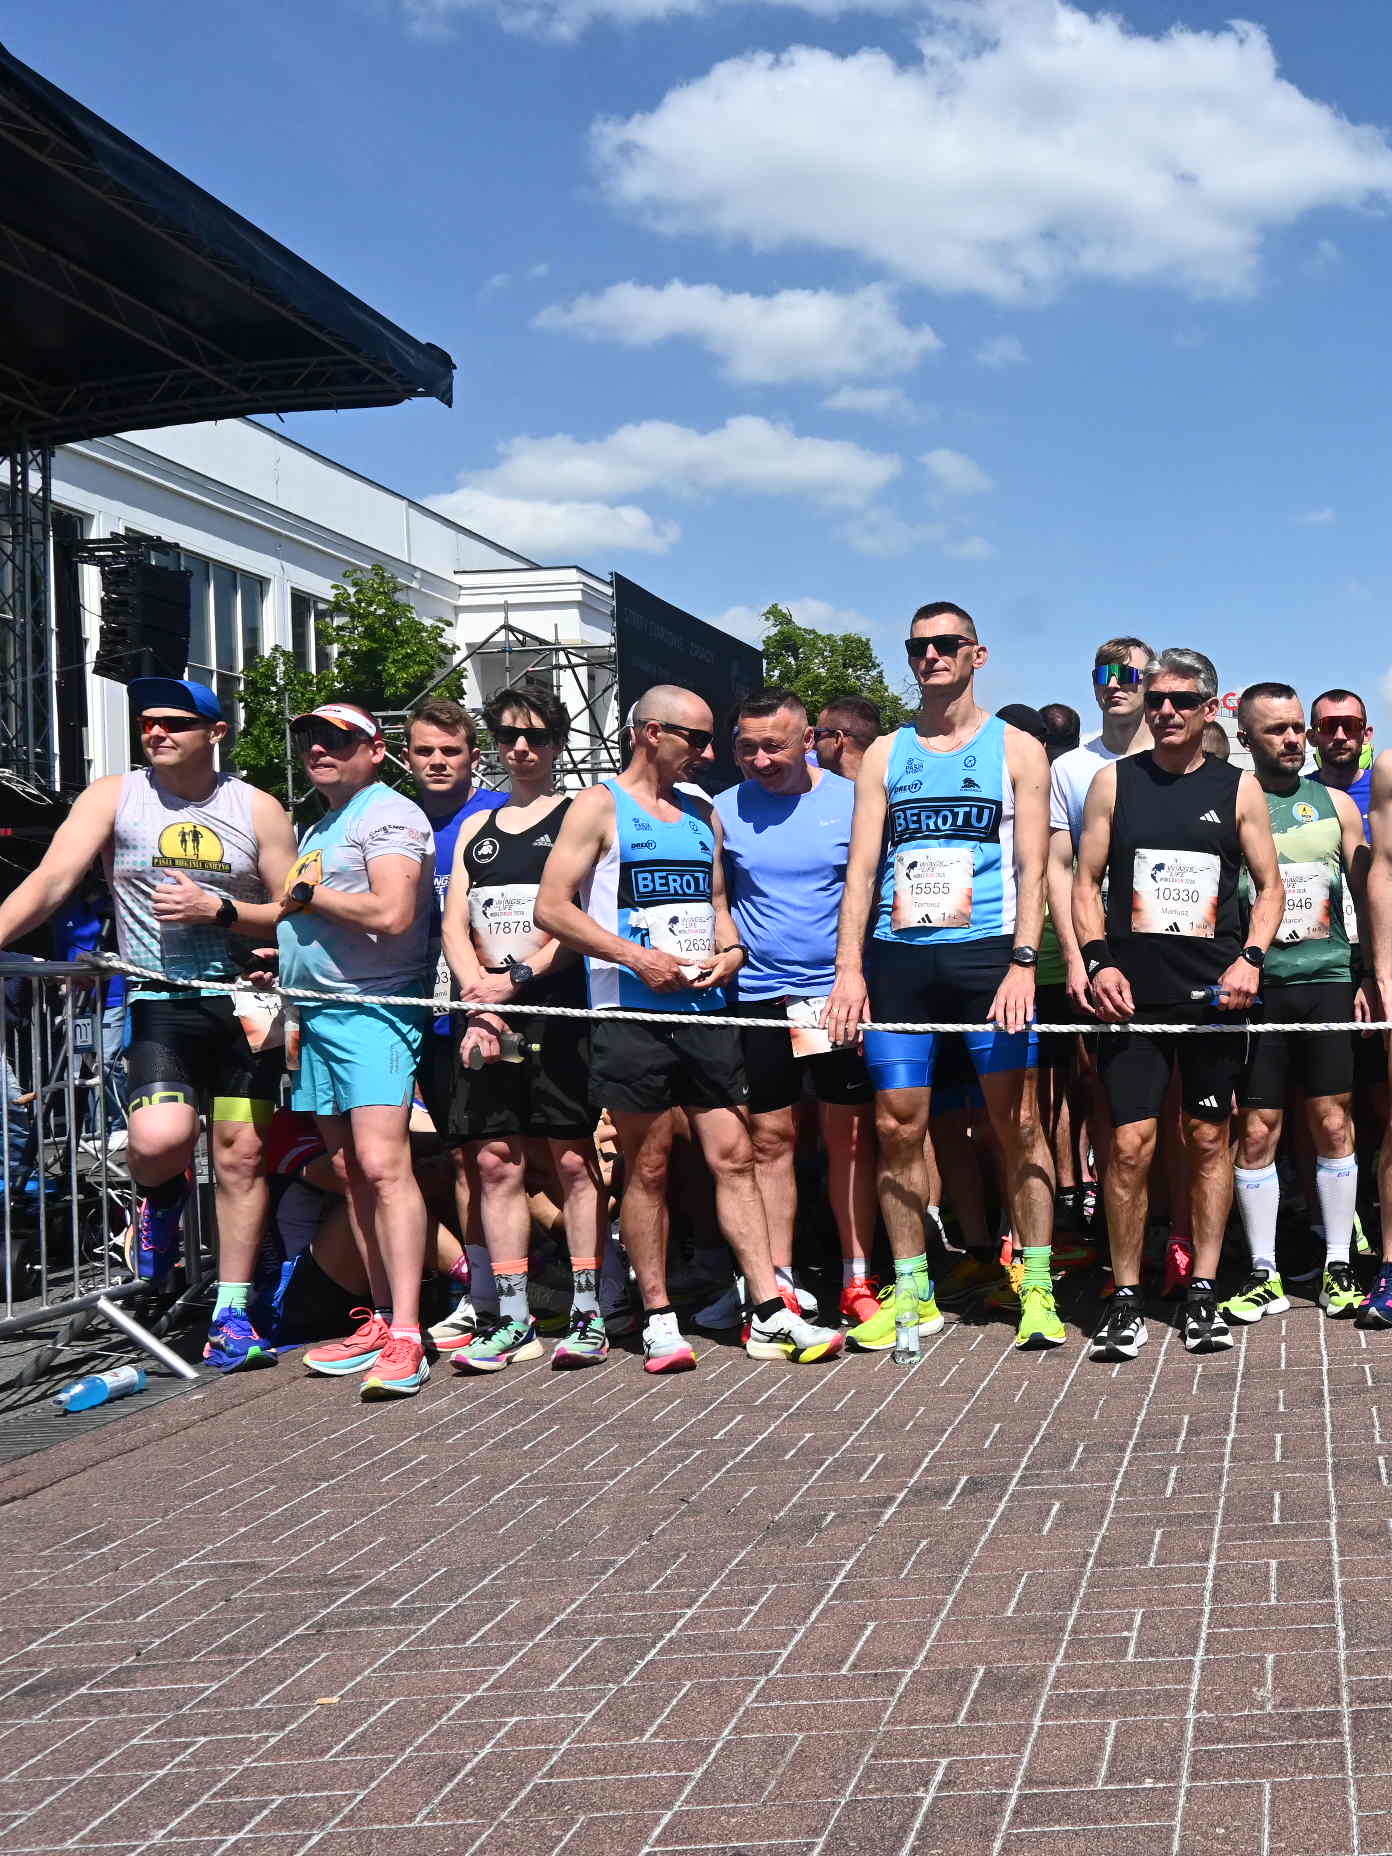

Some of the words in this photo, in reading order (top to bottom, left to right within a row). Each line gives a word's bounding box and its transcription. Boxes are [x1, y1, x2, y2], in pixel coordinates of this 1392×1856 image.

[894, 807, 990, 832] BEROTU
[909, 882, 950, 895] 15555
[1154, 887, 1200, 903] 10330
[1287, 898, 1312, 910] 946
[488, 920, 532, 934] 17878
[677, 938, 711, 952] 12632
